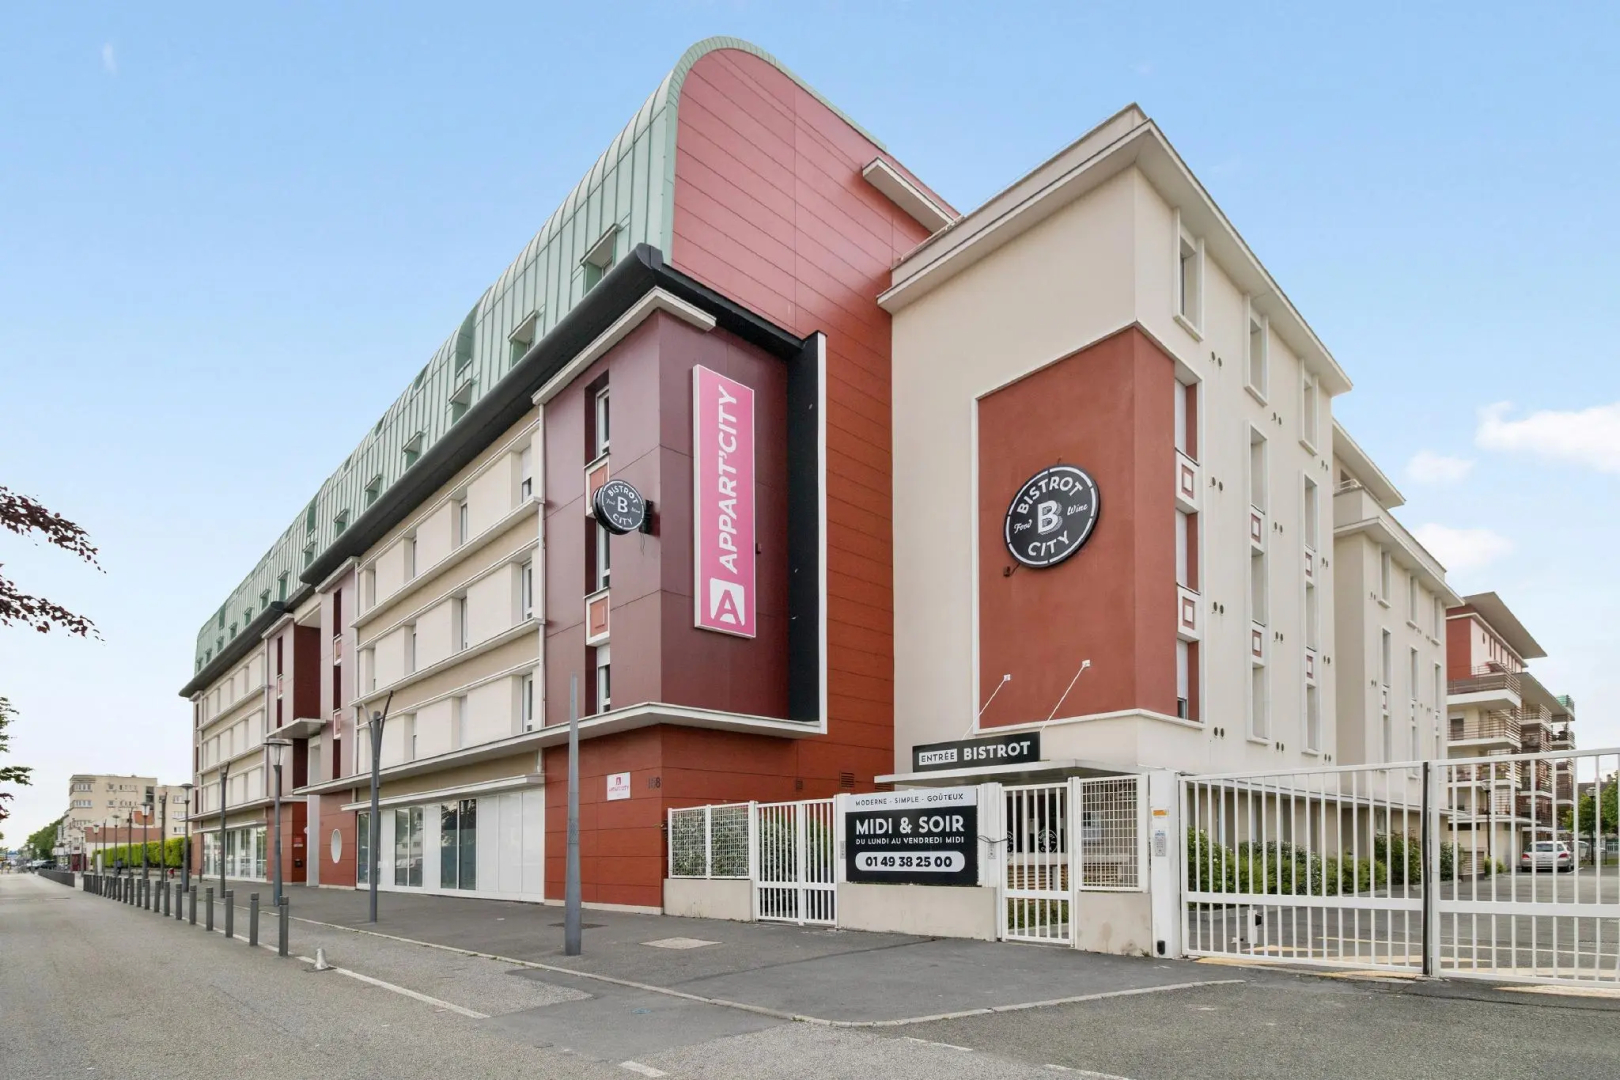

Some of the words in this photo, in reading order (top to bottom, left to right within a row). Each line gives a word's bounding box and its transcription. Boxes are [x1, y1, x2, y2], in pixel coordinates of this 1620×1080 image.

[718, 385, 737, 574] APPART'CITY
[607, 485, 639, 505] BISTROT
[617, 496, 629, 513] B
[1016, 476, 1083, 515] BISTROT
[612, 513, 633, 526] CITY
[1037, 500, 1063, 535] B
[1066, 503, 1088, 516] Wine
[1027, 530, 1070, 557] CITY
[920, 751, 955, 763] ENTRÉE
[963, 740, 1031, 761] BISTROT
[855, 798, 888, 807] MODERNE
[894, 796, 919, 804] SIMPLE
[927, 792, 964, 802] GOÛTEUX
[855, 818, 893, 835] MIDI
[899, 816, 913, 835] &
[918, 814, 965, 834] SOIR
[867, 837, 889, 845] LUNDI
[891, 837, 901, 845] AU
[903, 836, 943, 844] VENDREDI
[945, 836, 965, 844] MIDI
[865, 856, 878, 867] 01
[880, 856, 896, 867] 49
[898, 856, 913, 867] 38
[915, 856, 931, 867] 25
[934, 856, 953, 868] 00
